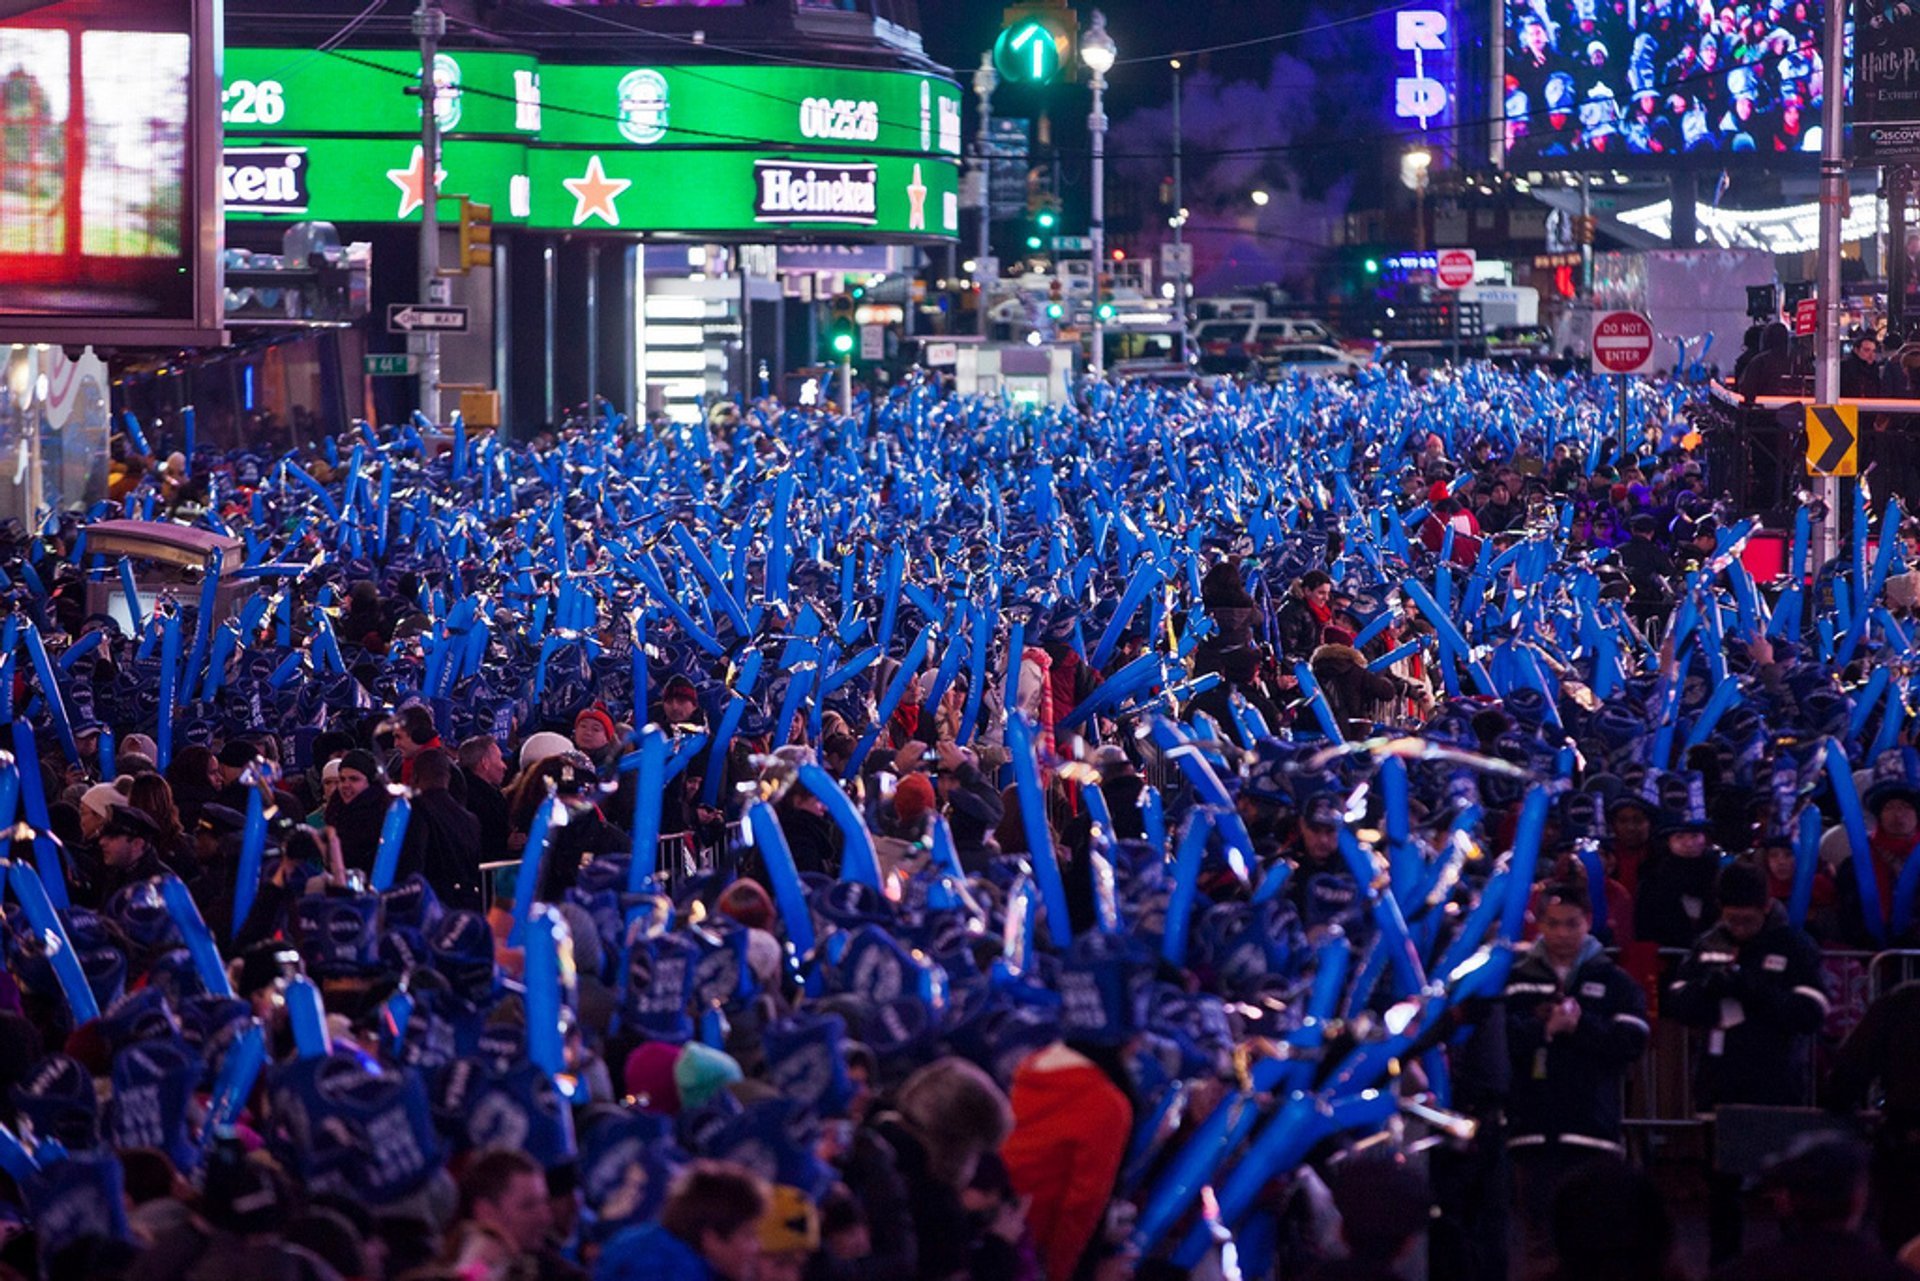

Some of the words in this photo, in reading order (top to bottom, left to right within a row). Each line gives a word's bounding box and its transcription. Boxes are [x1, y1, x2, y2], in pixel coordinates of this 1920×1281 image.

[801, 98, 878, 141] 00:25:26
[761, 170, 875, 213] Heineken
[402, 313, 421, 325] ONE
[435, 315, 458, 323] WAY
[1603, 323, 1618, 334] DO
[1621, 323, 1642, 334] NOT
[1605, 351, 1640, 361] ENTER
